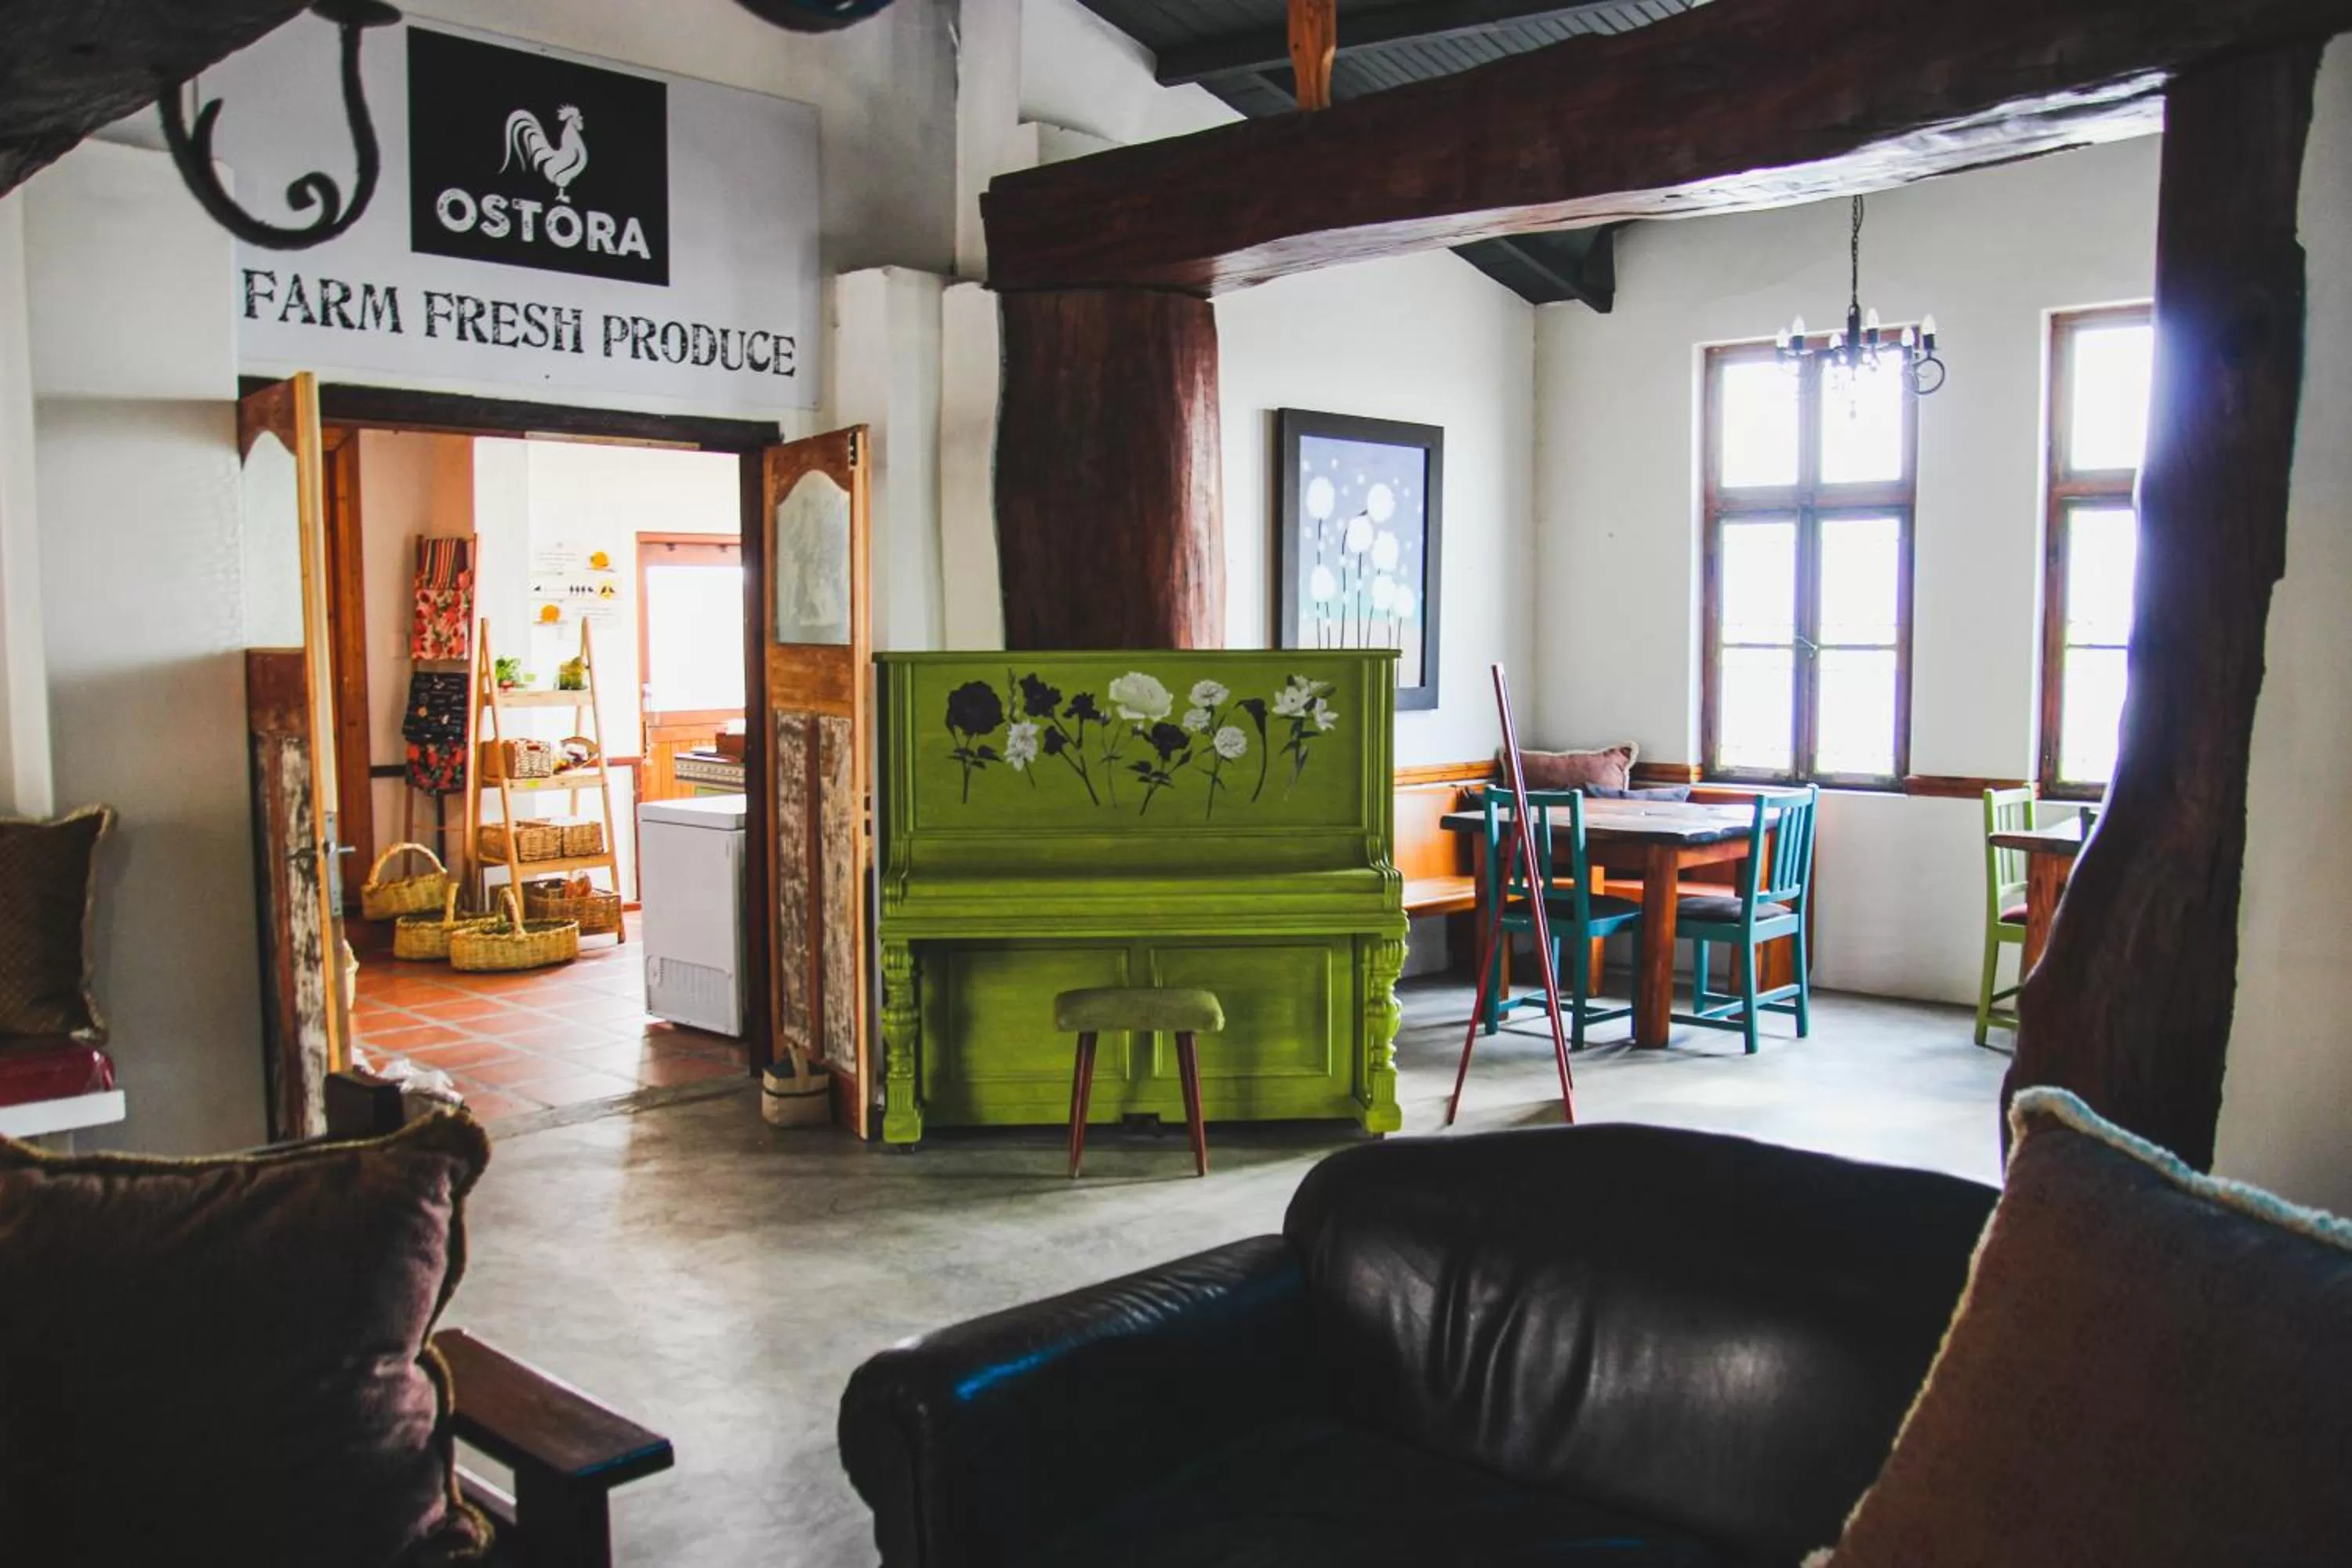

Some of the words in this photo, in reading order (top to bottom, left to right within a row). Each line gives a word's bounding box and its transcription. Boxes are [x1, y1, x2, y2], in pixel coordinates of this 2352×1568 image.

[242, 267, 404, 335] FARM
[423, 290, 584, 354] FRESH
[602, 314, 797, 378] PRODUCE
